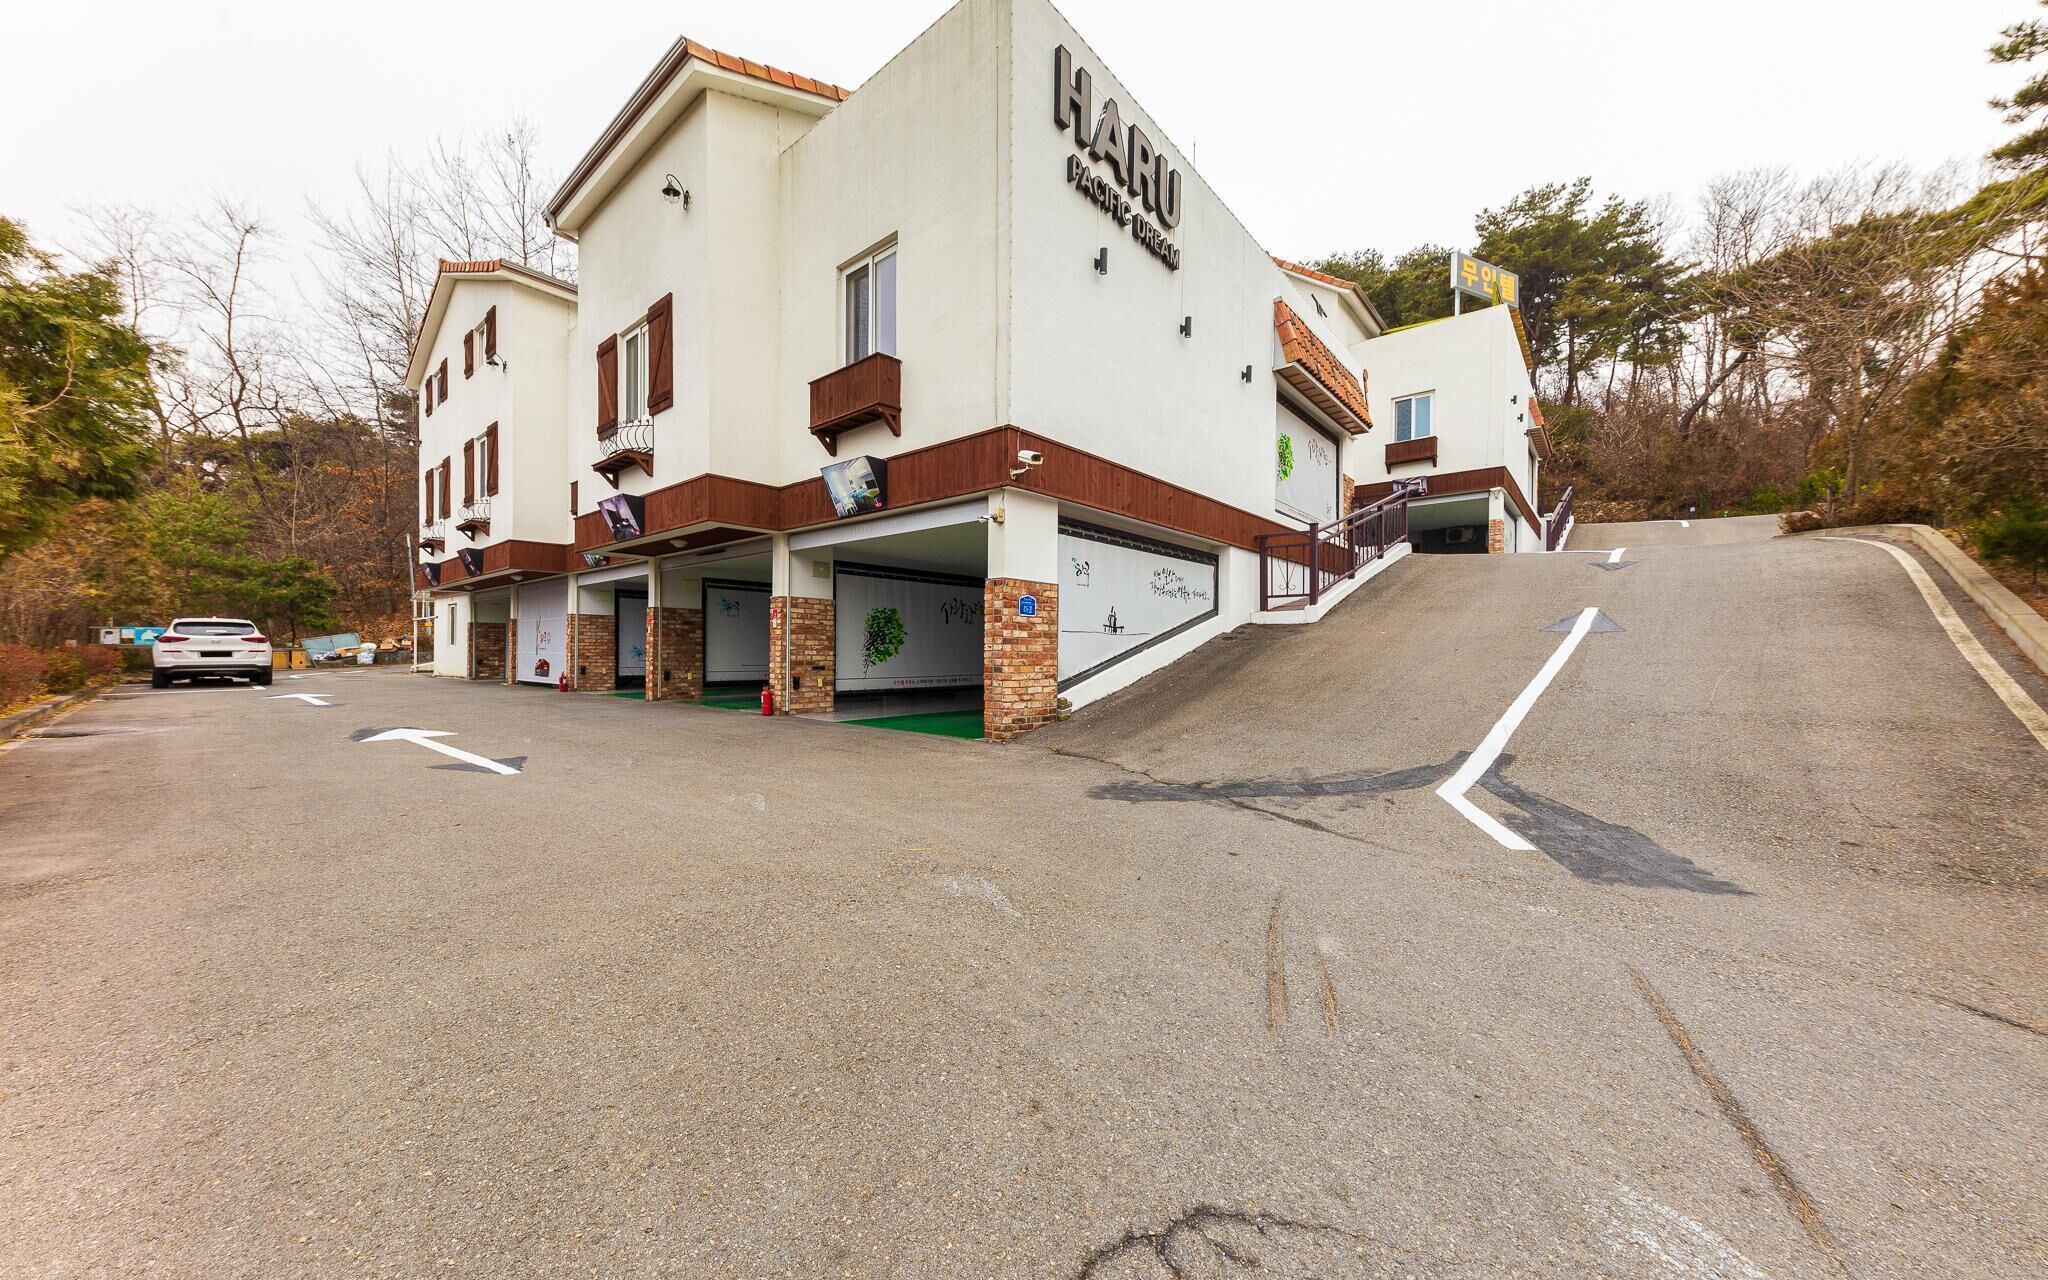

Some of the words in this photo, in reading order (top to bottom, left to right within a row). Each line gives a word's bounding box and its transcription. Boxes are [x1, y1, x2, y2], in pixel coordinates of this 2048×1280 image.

[1054, 44, 1181, 230] HARU
[1067, 153, 1132, 228] PACIFIC
[1132, 212, 1181, 271] DREAM
[1461, 258, 1515, 302] 무인텔
